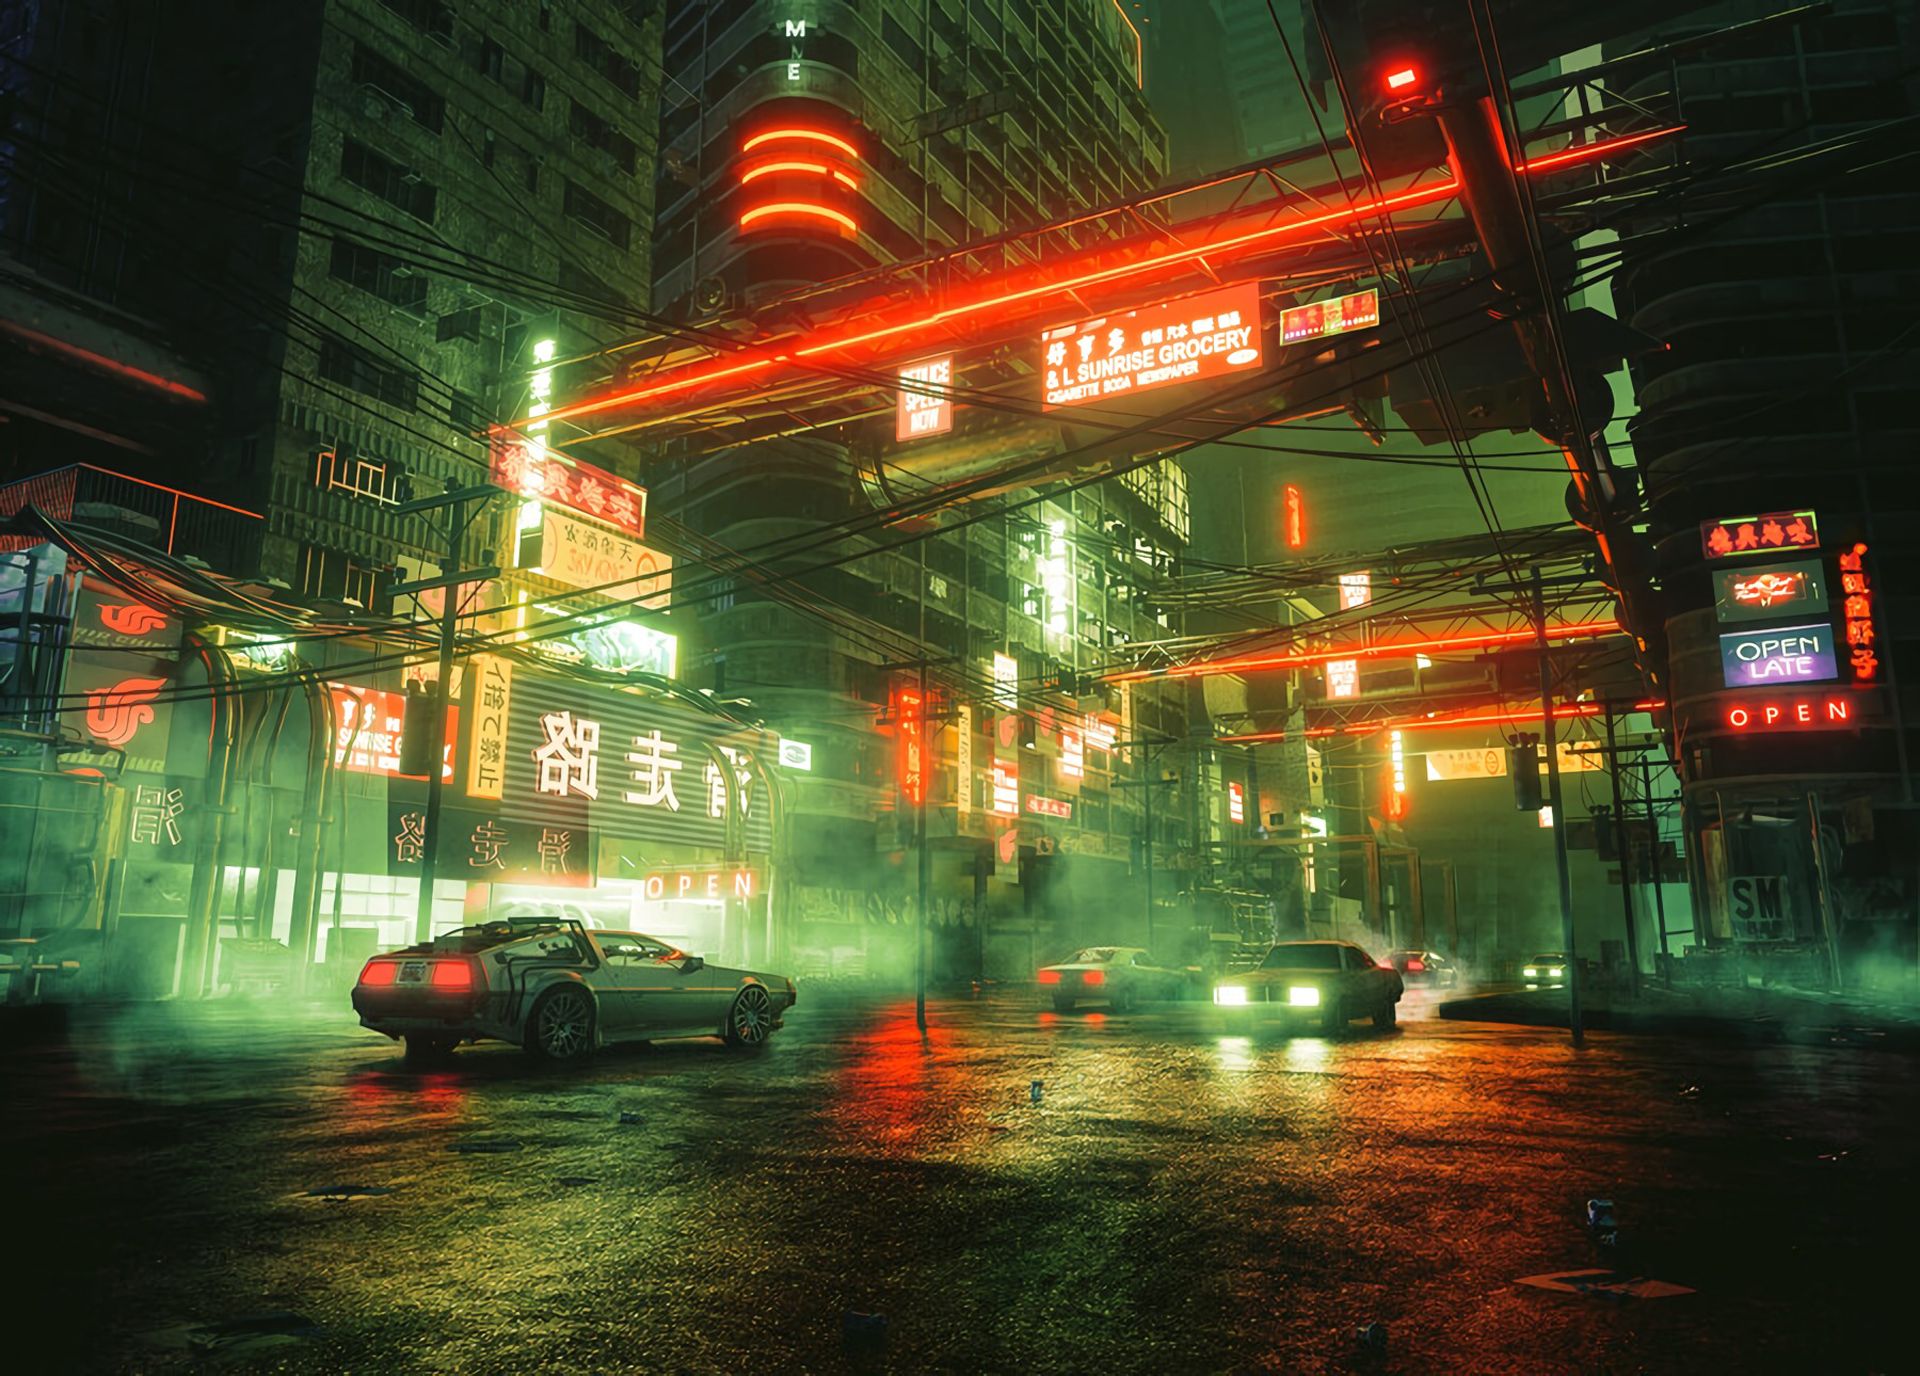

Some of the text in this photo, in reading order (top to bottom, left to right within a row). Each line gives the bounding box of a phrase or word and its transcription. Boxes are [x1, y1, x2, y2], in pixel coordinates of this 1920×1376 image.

[1077, 348, 1155, 383] SUNRISE
[1158, 326, 1252, 364] GROCERY
[1735, 636, 1820, 662] OPEN
[1749, 656, 1814, 679] LATE
[1730, 701, 1847, 727] OPEN
[646, 872, 752, 899] OPEN
